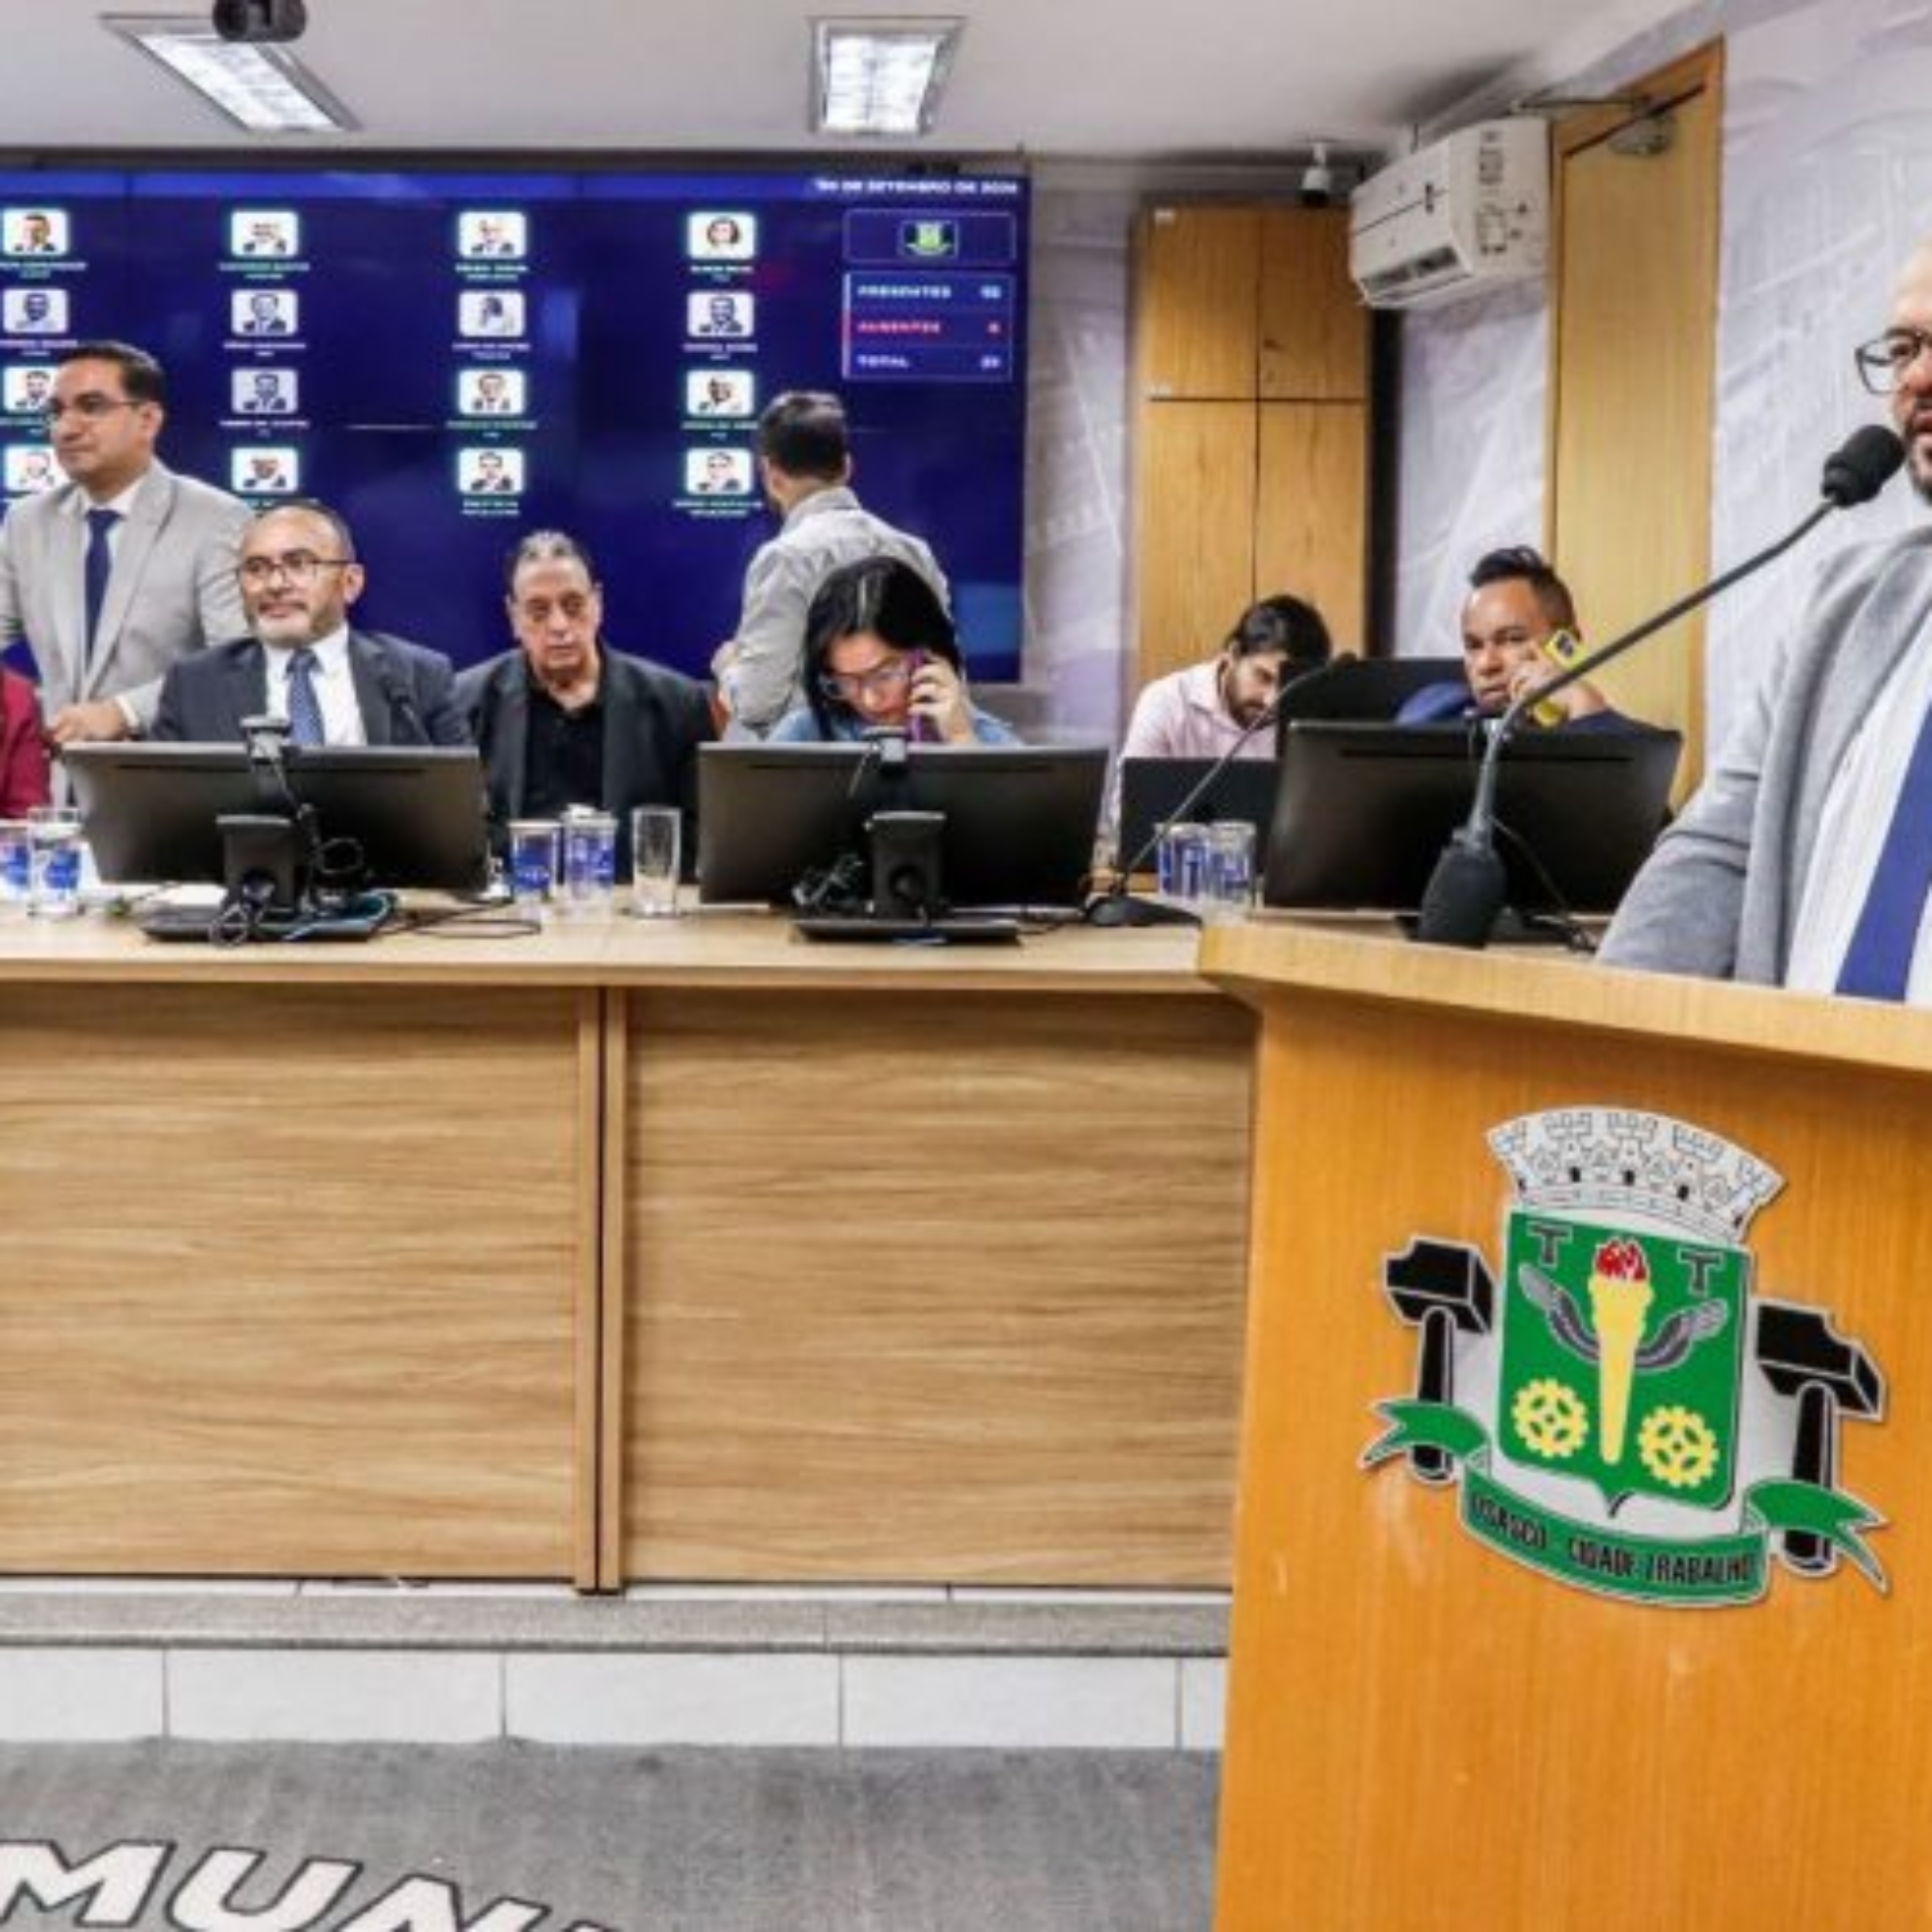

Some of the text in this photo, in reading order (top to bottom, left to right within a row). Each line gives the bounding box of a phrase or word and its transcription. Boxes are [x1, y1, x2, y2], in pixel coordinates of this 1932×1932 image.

[856, 354, 910, 369] TOTAL
[1528, 1222, 1723, 1296] T T
[1568, 1537, 1634, 1577] CIDADE
